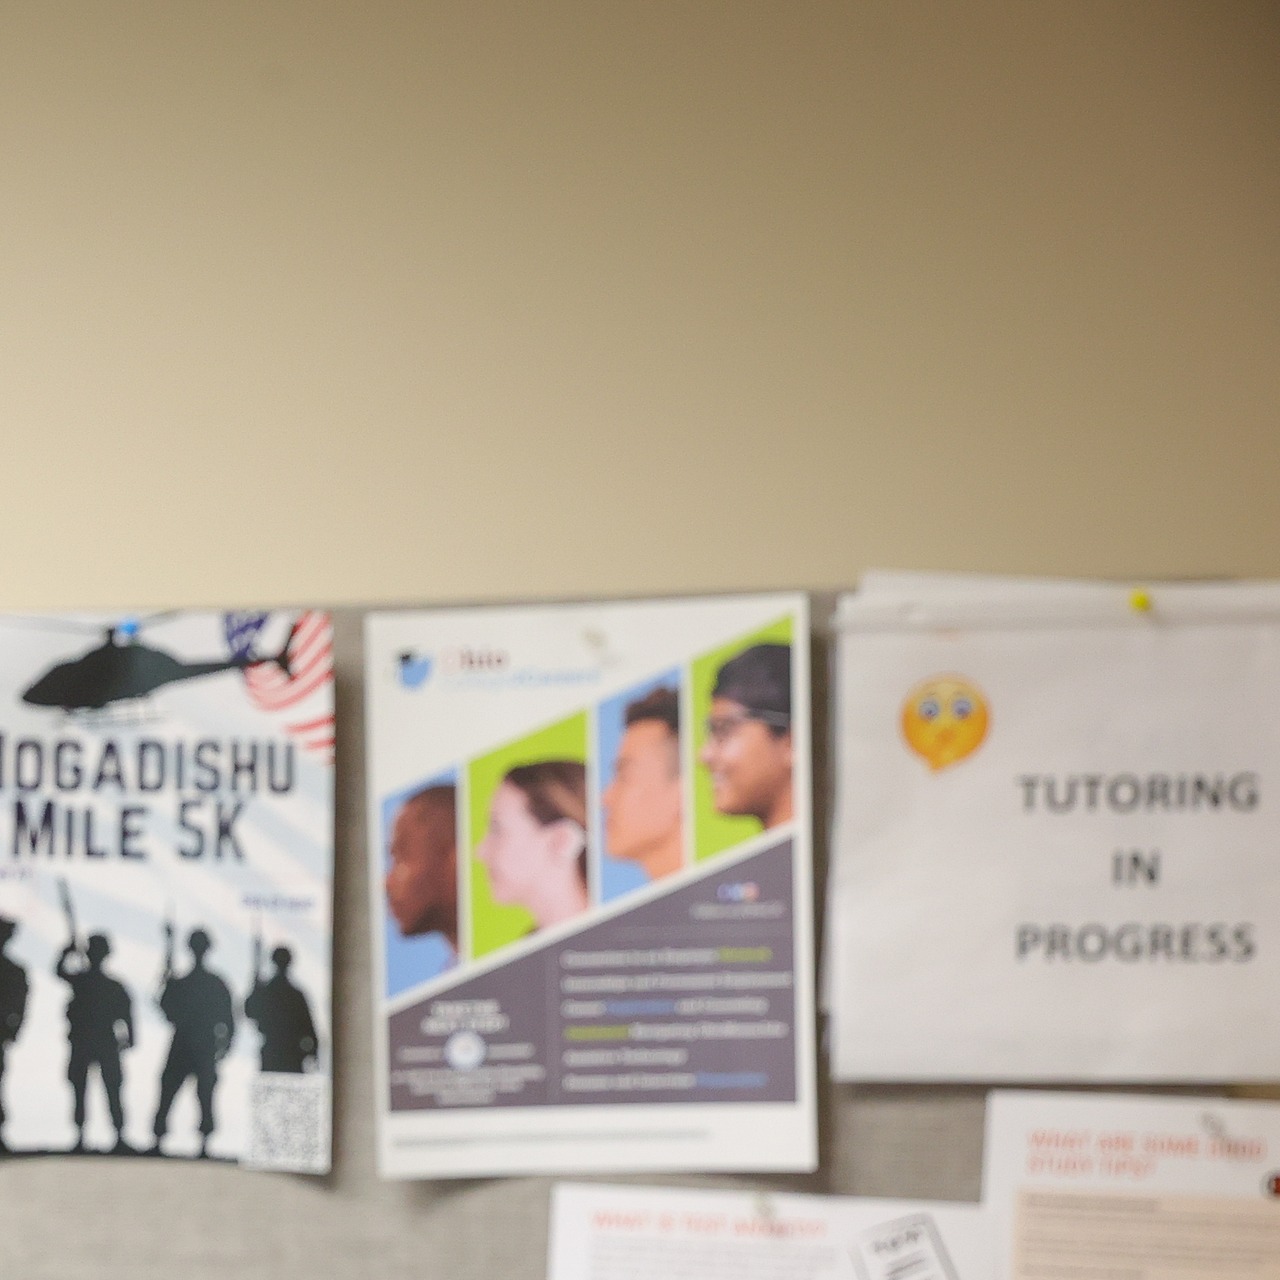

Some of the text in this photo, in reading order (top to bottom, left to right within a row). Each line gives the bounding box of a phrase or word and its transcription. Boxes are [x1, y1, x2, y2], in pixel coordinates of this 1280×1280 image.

[1016, 772, 1261, 814] TUTORING
[12, 799, 245, 858] MILE 5K
[1111, 848, 1160, 887] IN
[1015, 921, 1256, 964] PROGRESS
